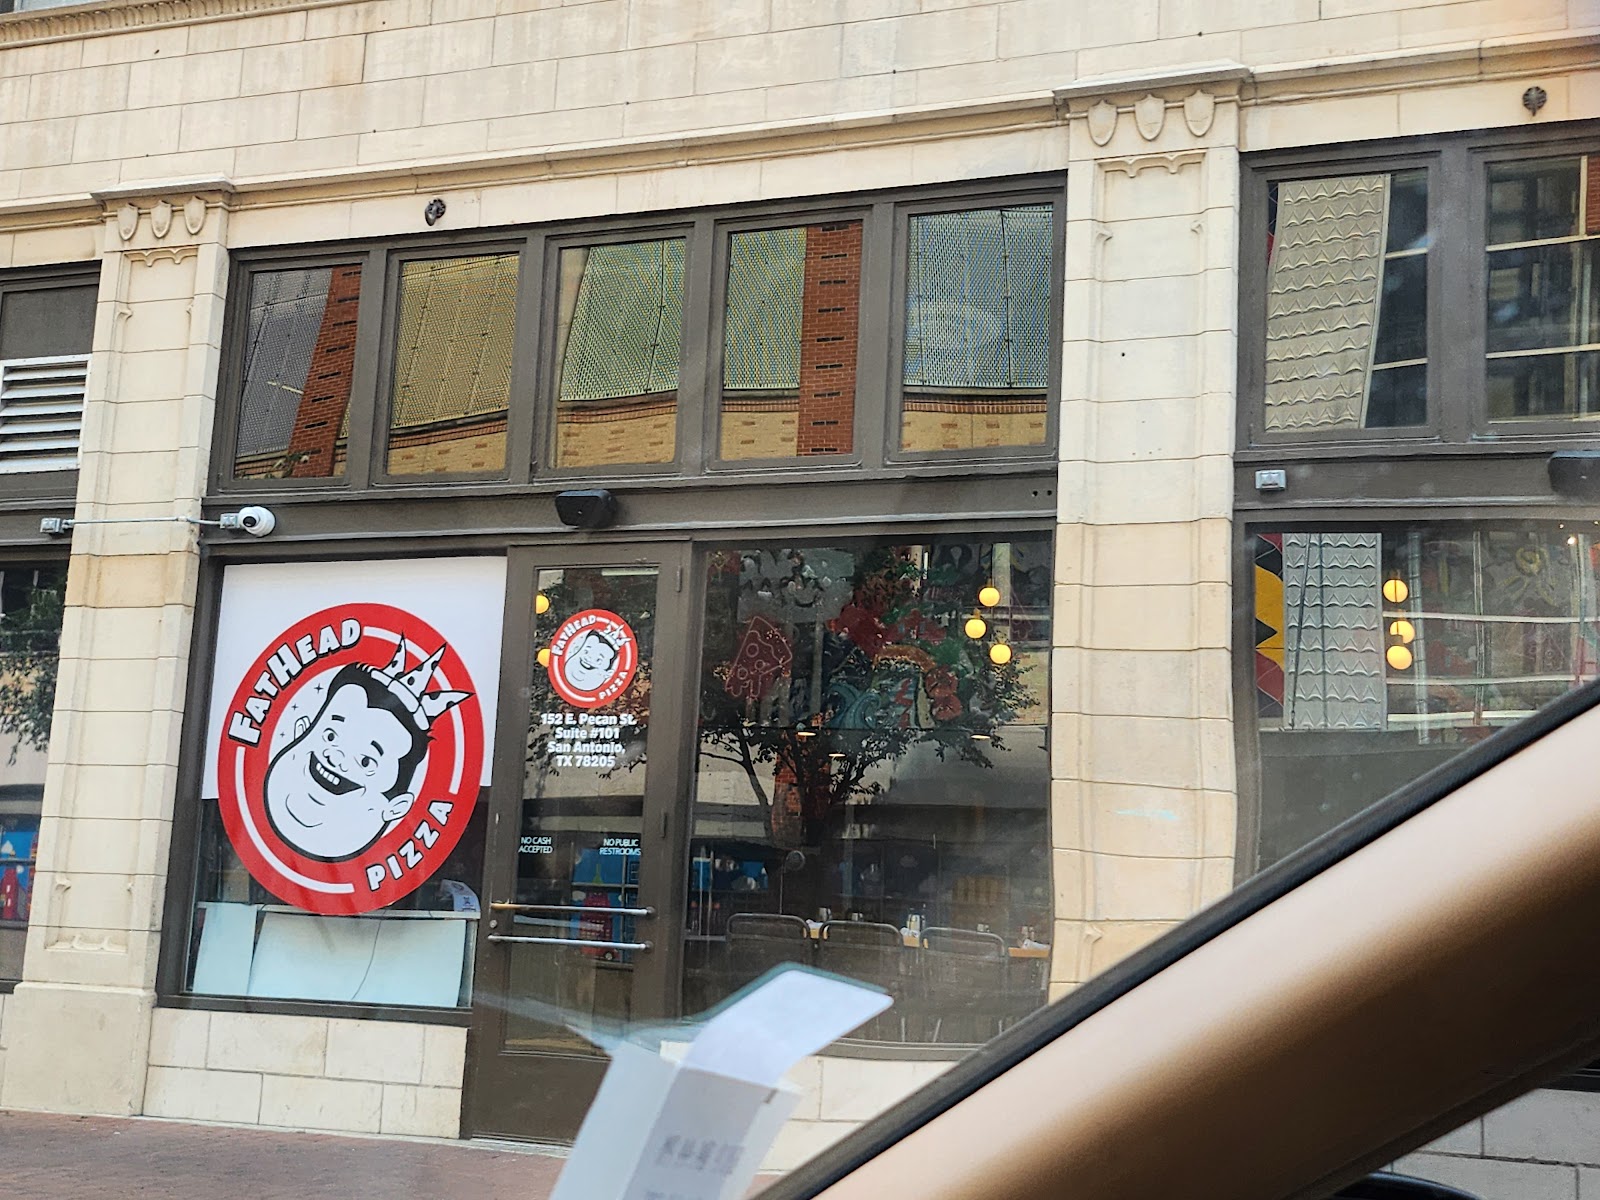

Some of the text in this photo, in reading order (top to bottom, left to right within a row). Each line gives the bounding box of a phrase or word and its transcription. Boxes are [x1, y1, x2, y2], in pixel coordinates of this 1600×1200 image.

[228, 618, 362, 747] FATHEAD
[599, 671, 628, 700] PIZZA
[541, 713, 637, 726] 152 E. Pecan St.
[555, 727, 620, 739] Suite #101
[547, 741, 626, 754] San Antonio,
[556, 755, 616, 767] TX 78205
[365, 800, 454, 892] PIZZA
[521, 836, 552, 845] NO CASH
[603, 838, 639, 847] NO PUBLIC
[518, 845, 553, 854] ACCEPTED
[599, 847, 641, 856] RESTROOMS
